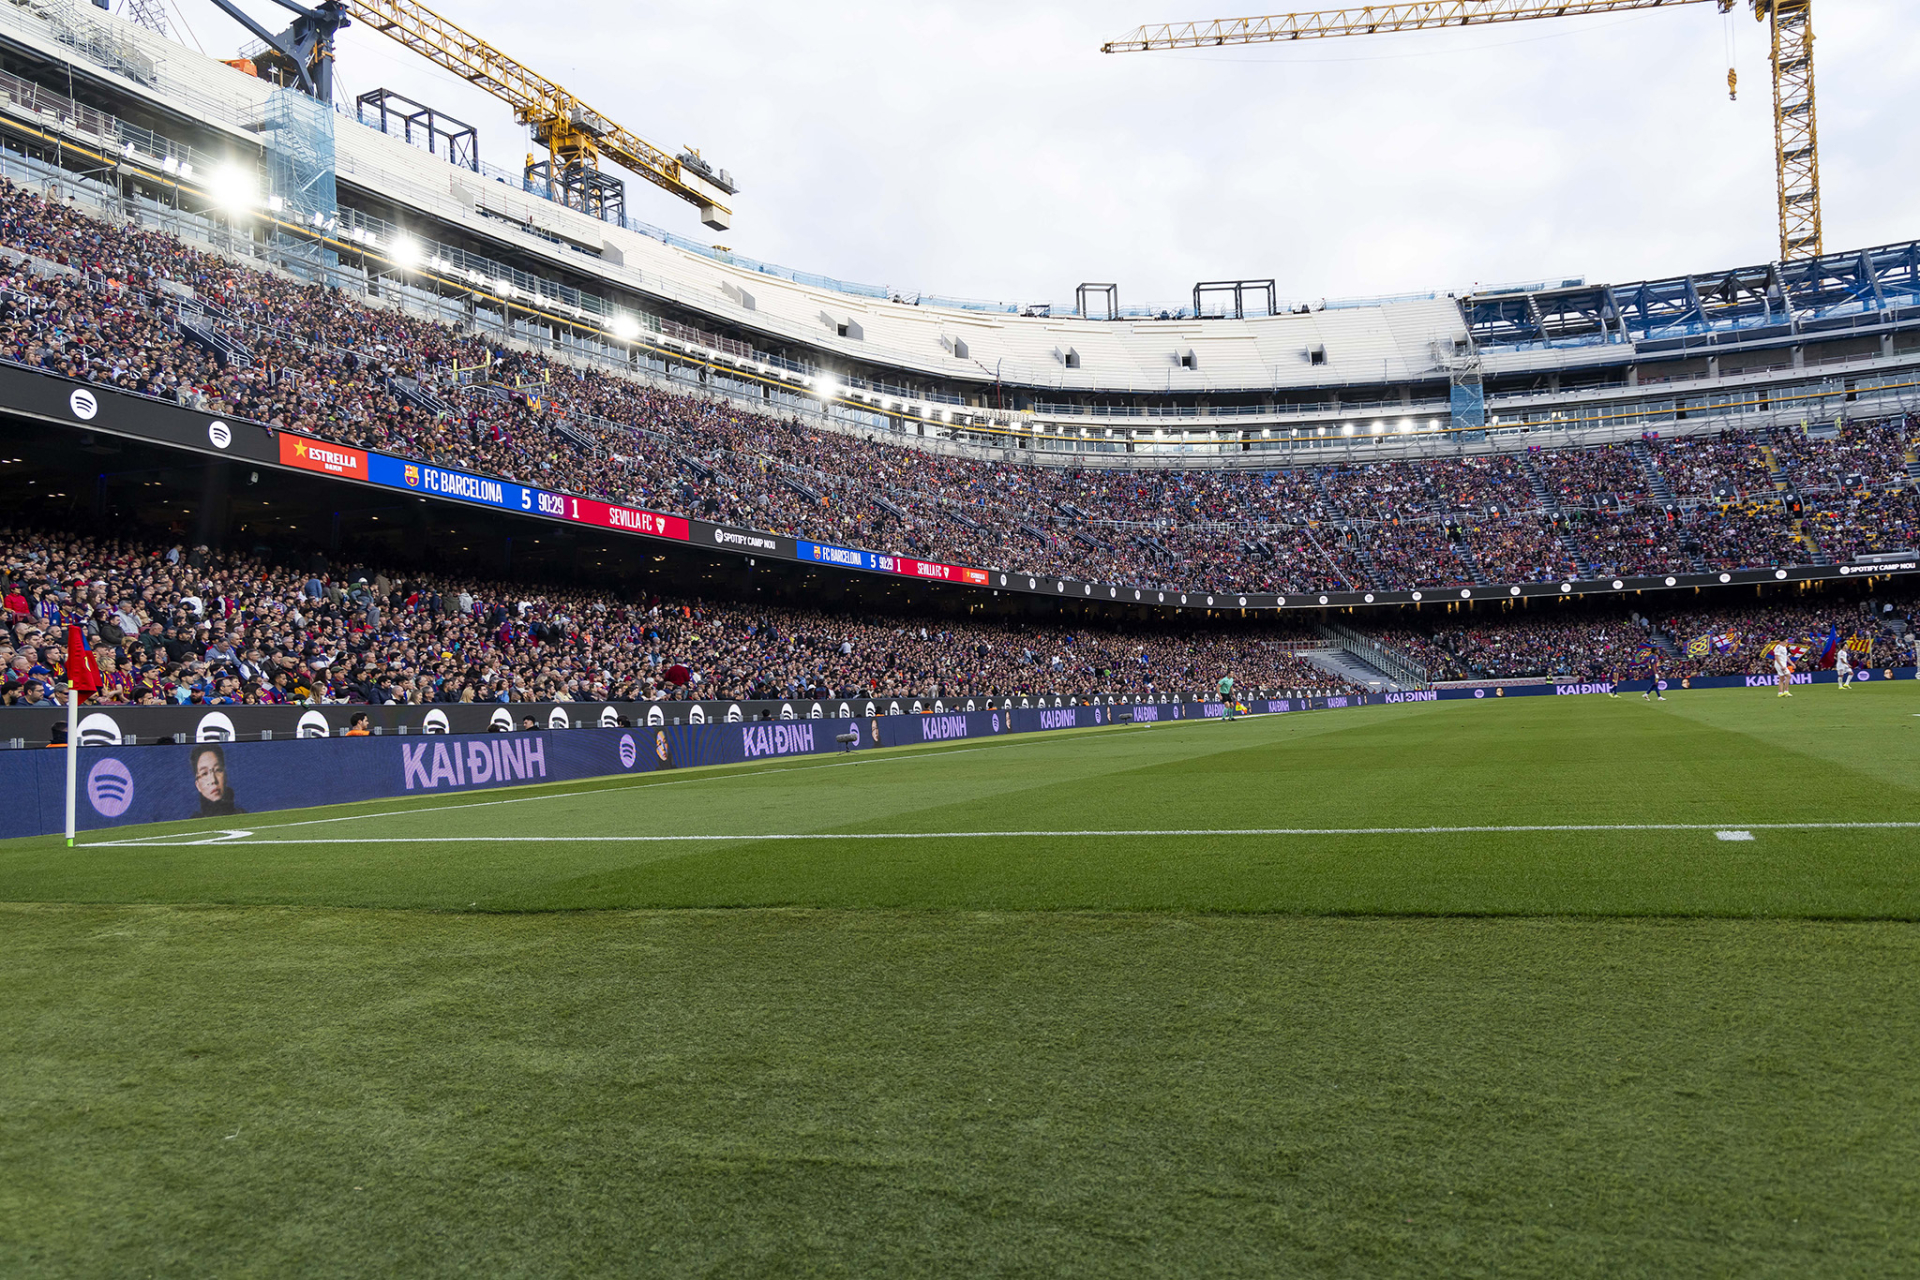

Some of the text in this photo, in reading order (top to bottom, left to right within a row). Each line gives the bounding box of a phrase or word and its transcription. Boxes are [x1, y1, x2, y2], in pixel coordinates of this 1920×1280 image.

[308, 447, 357, 468] ESTRELLA
[424, 468, 652, 531] FC BARCELONA 5 90:29 1 SEVILLA FC
[723, 532, 776, 549] SPOTIFY CAMP NOU
[822, 546, 830, 561] FC
[830, 548, 862, 566] BARCELONA
[870, 554, 877, 568] 5
[896, 558, 901, 572] 1
[917, 562, 935, 577] SEVILLA
[1556, 684, 1580, 696] KAI
[1745, 675, 1772, 687] KAI
[1385, 692, 1405, 704] KAI
[922, 715, 967, 740] KAI ĐINH
[1040, 710, 1055, 729] KAI
[742, 723, 815, 757] KAI ĐINH
[402, 737, 546, 790] KAI ĐINH
